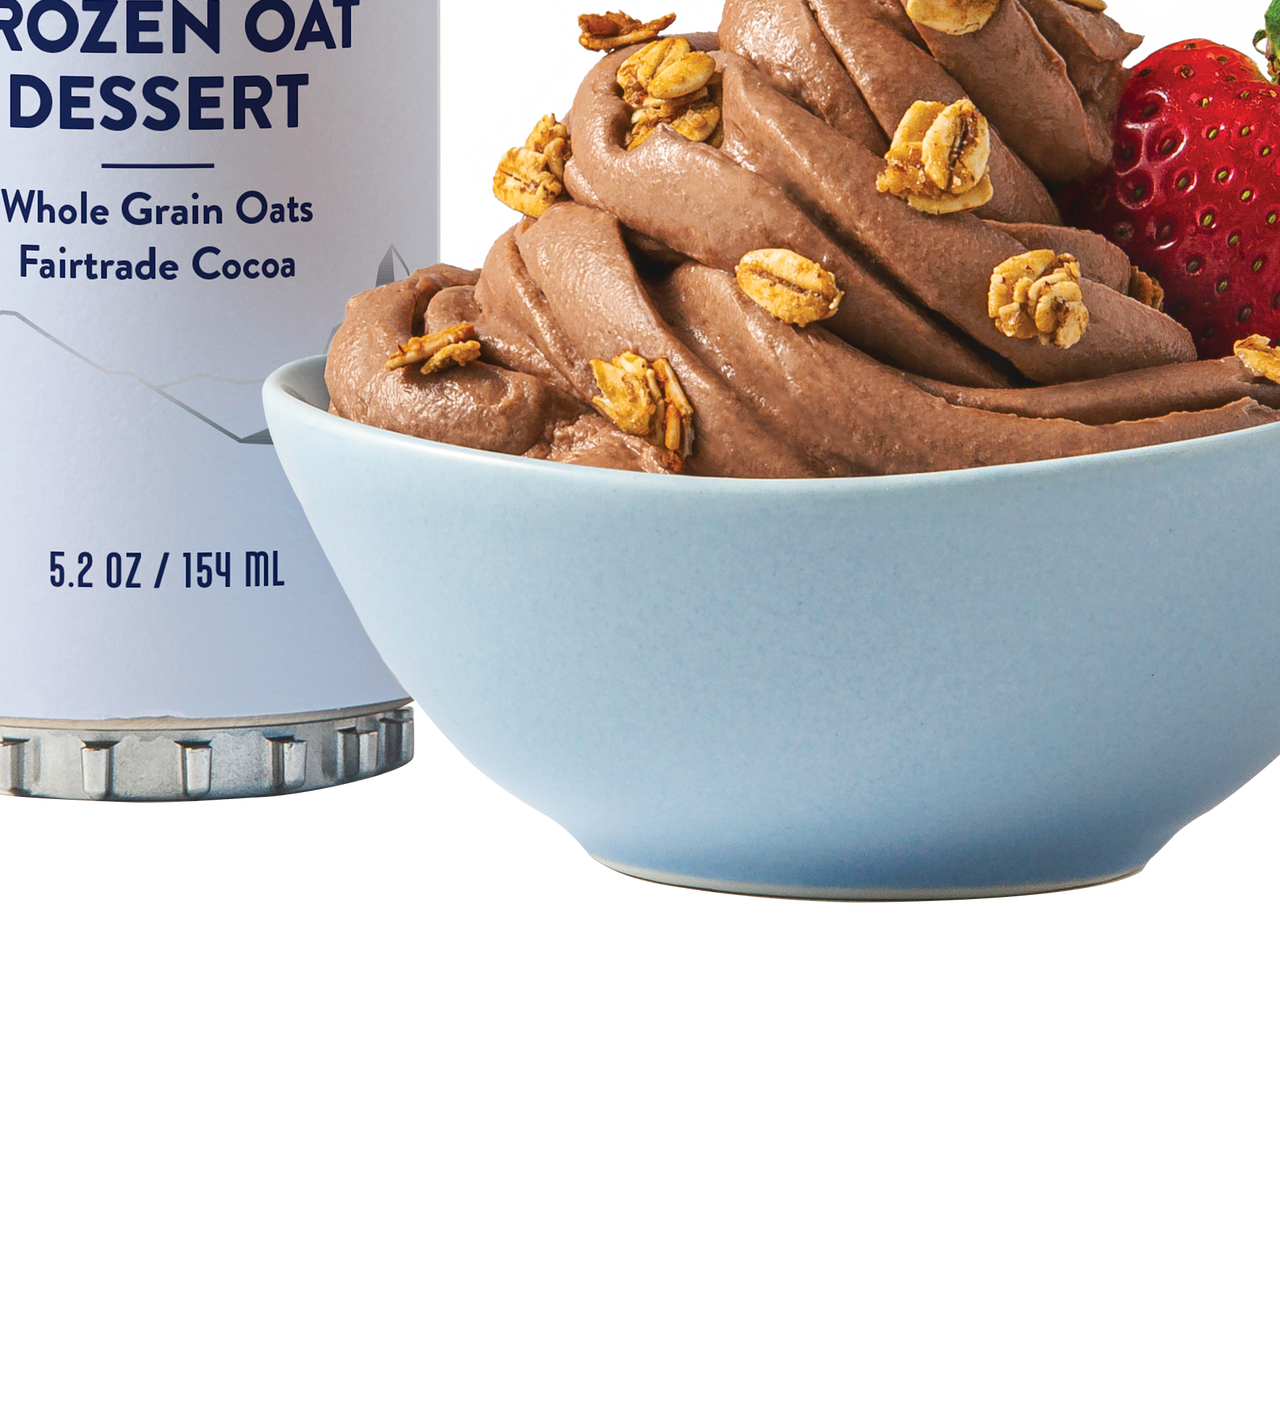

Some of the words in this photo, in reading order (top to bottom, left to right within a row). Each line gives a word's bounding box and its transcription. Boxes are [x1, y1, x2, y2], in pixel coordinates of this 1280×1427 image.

[9, 73, 309, 132] DESSERT
[1, 188, 110, 226] Whole
[121, 192, 223, 226] Grain
[235, 190, 314, 225] Oats
[19, 244, 179, 281] Fairtrade
[191, 246, 296, 281] Cocoa
[49, 551, 95, 588] 5.2
[105, 552, 143, 589] OZ
[153, 552, 171, 589] /
[183, 551, 232, 589] 154
[245, 550, 285, 587] ML
